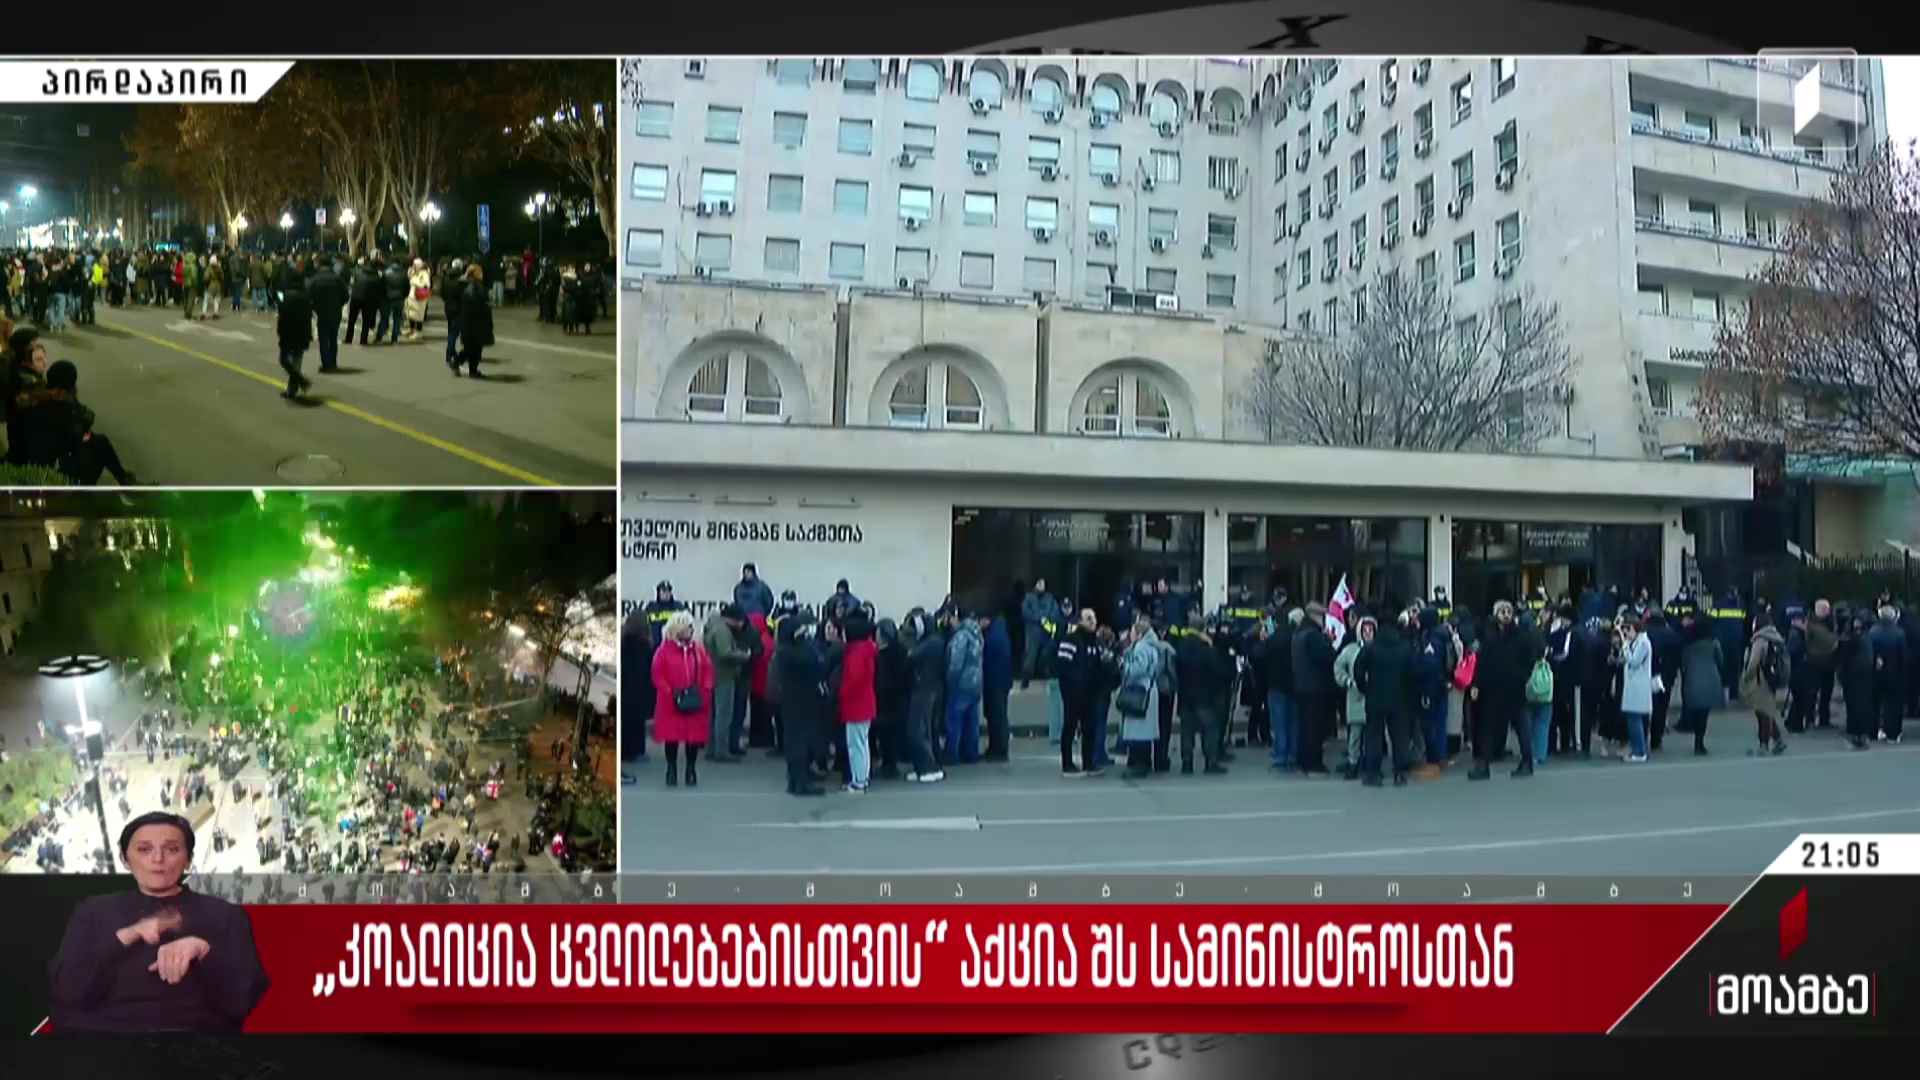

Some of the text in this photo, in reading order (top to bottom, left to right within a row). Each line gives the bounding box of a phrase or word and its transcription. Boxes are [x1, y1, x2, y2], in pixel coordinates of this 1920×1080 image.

[706, 521, 780, 541] შინაგან
[785, 522, 863, 543] საქმეთა
[621, 541, 677, 560] სტრო
